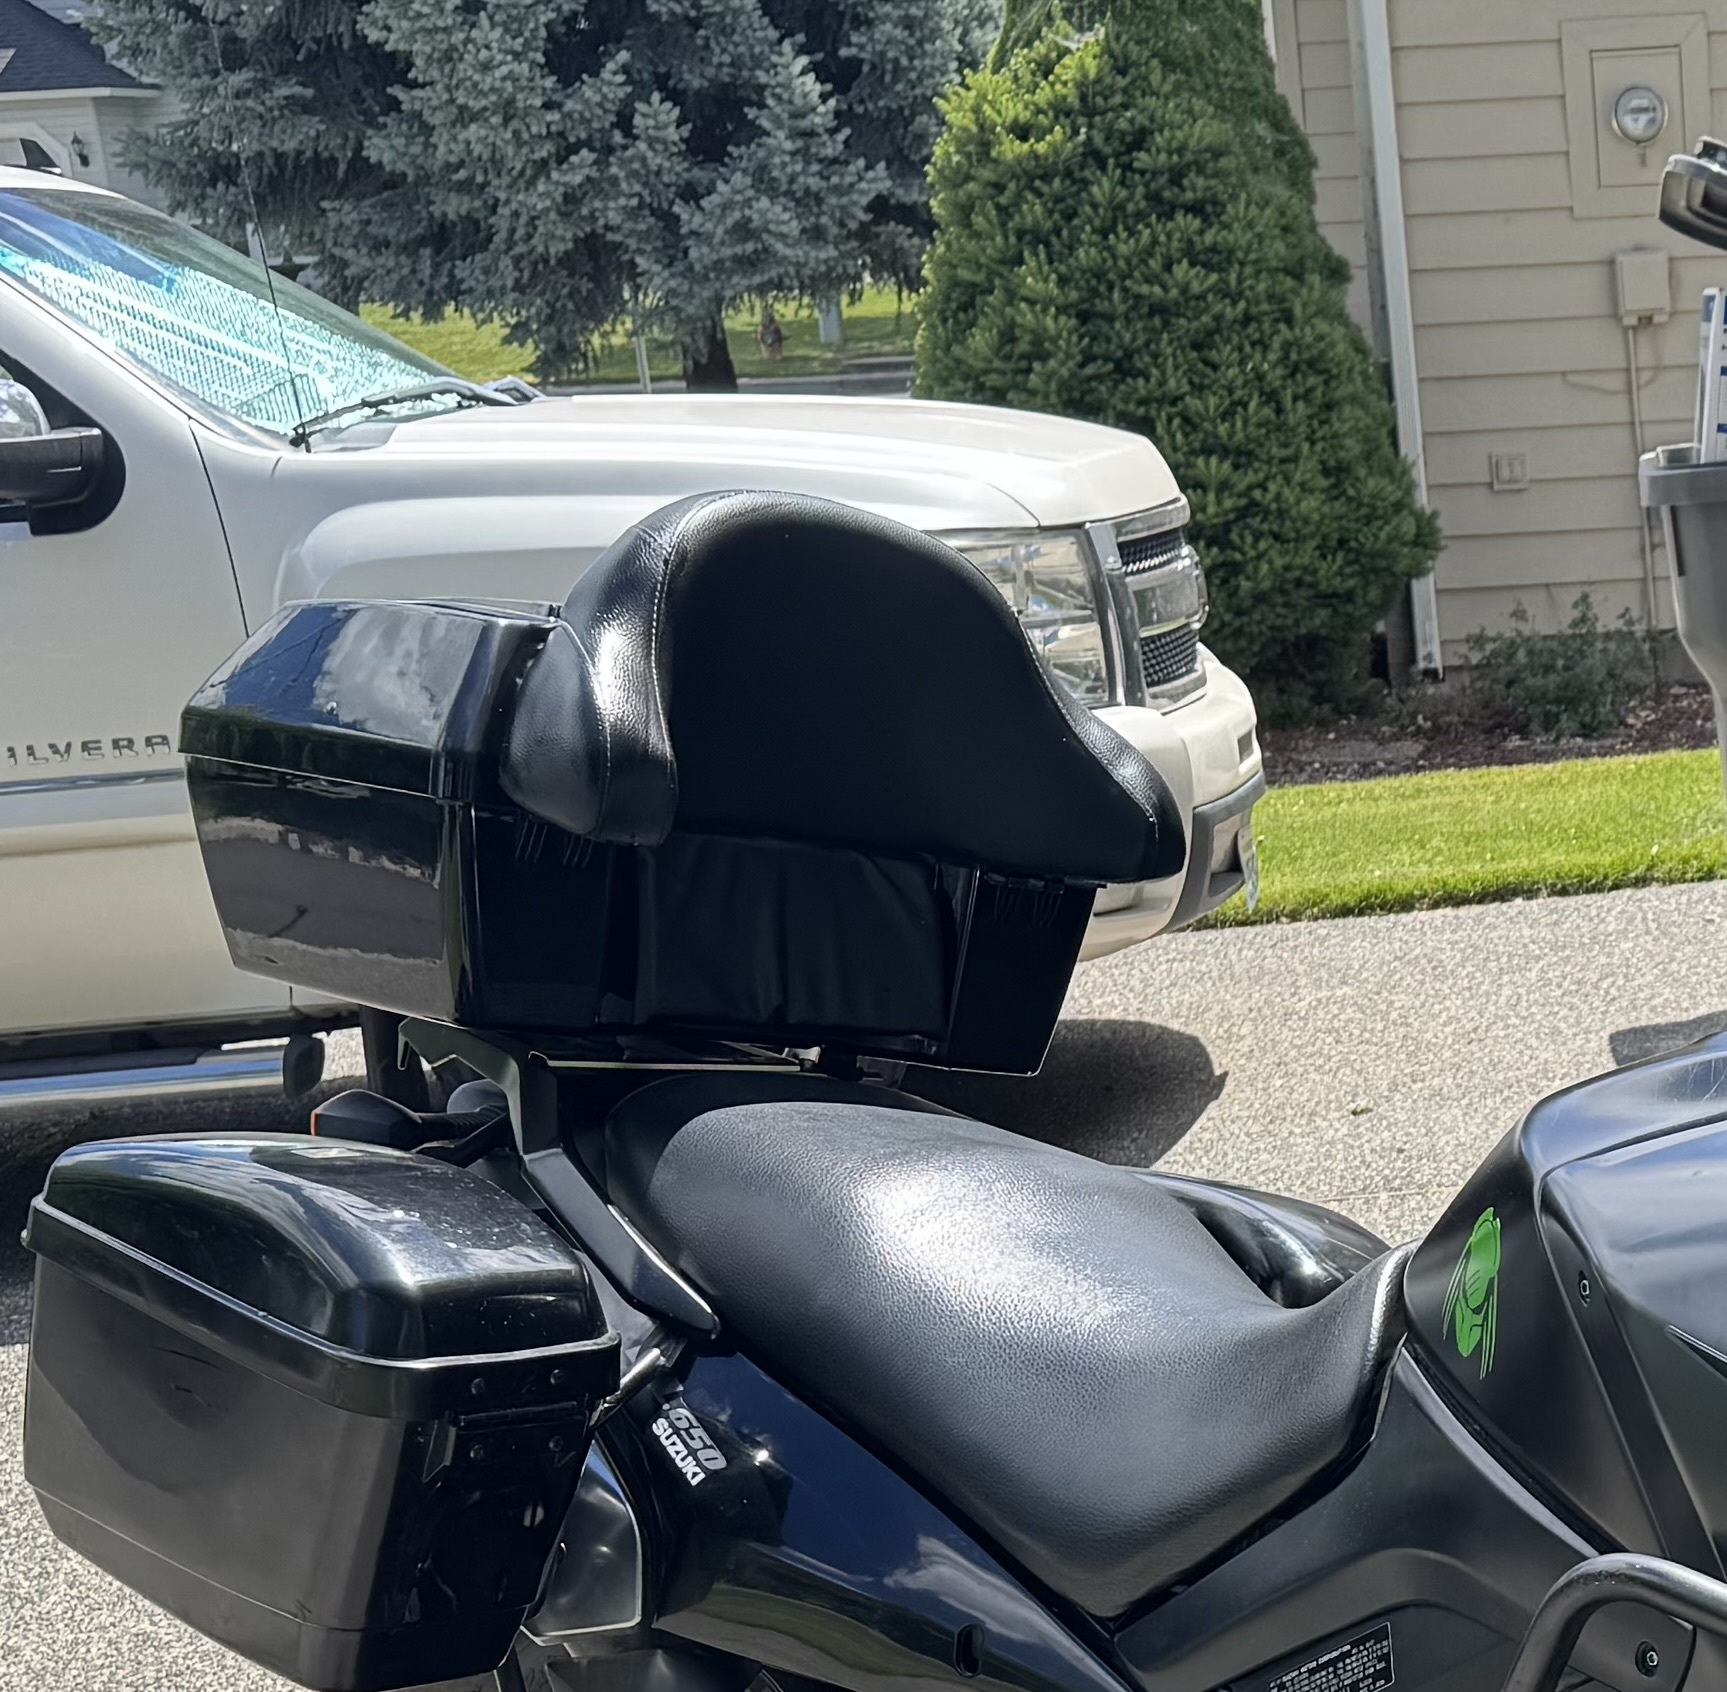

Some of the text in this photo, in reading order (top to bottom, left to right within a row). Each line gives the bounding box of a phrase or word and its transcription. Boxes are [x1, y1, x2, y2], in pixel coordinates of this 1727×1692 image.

[7, 734, 172, 767] ILVERA
[652, 1417, 707, 1487] SUZUKI
[668, 1407, 728, 1470] 650
